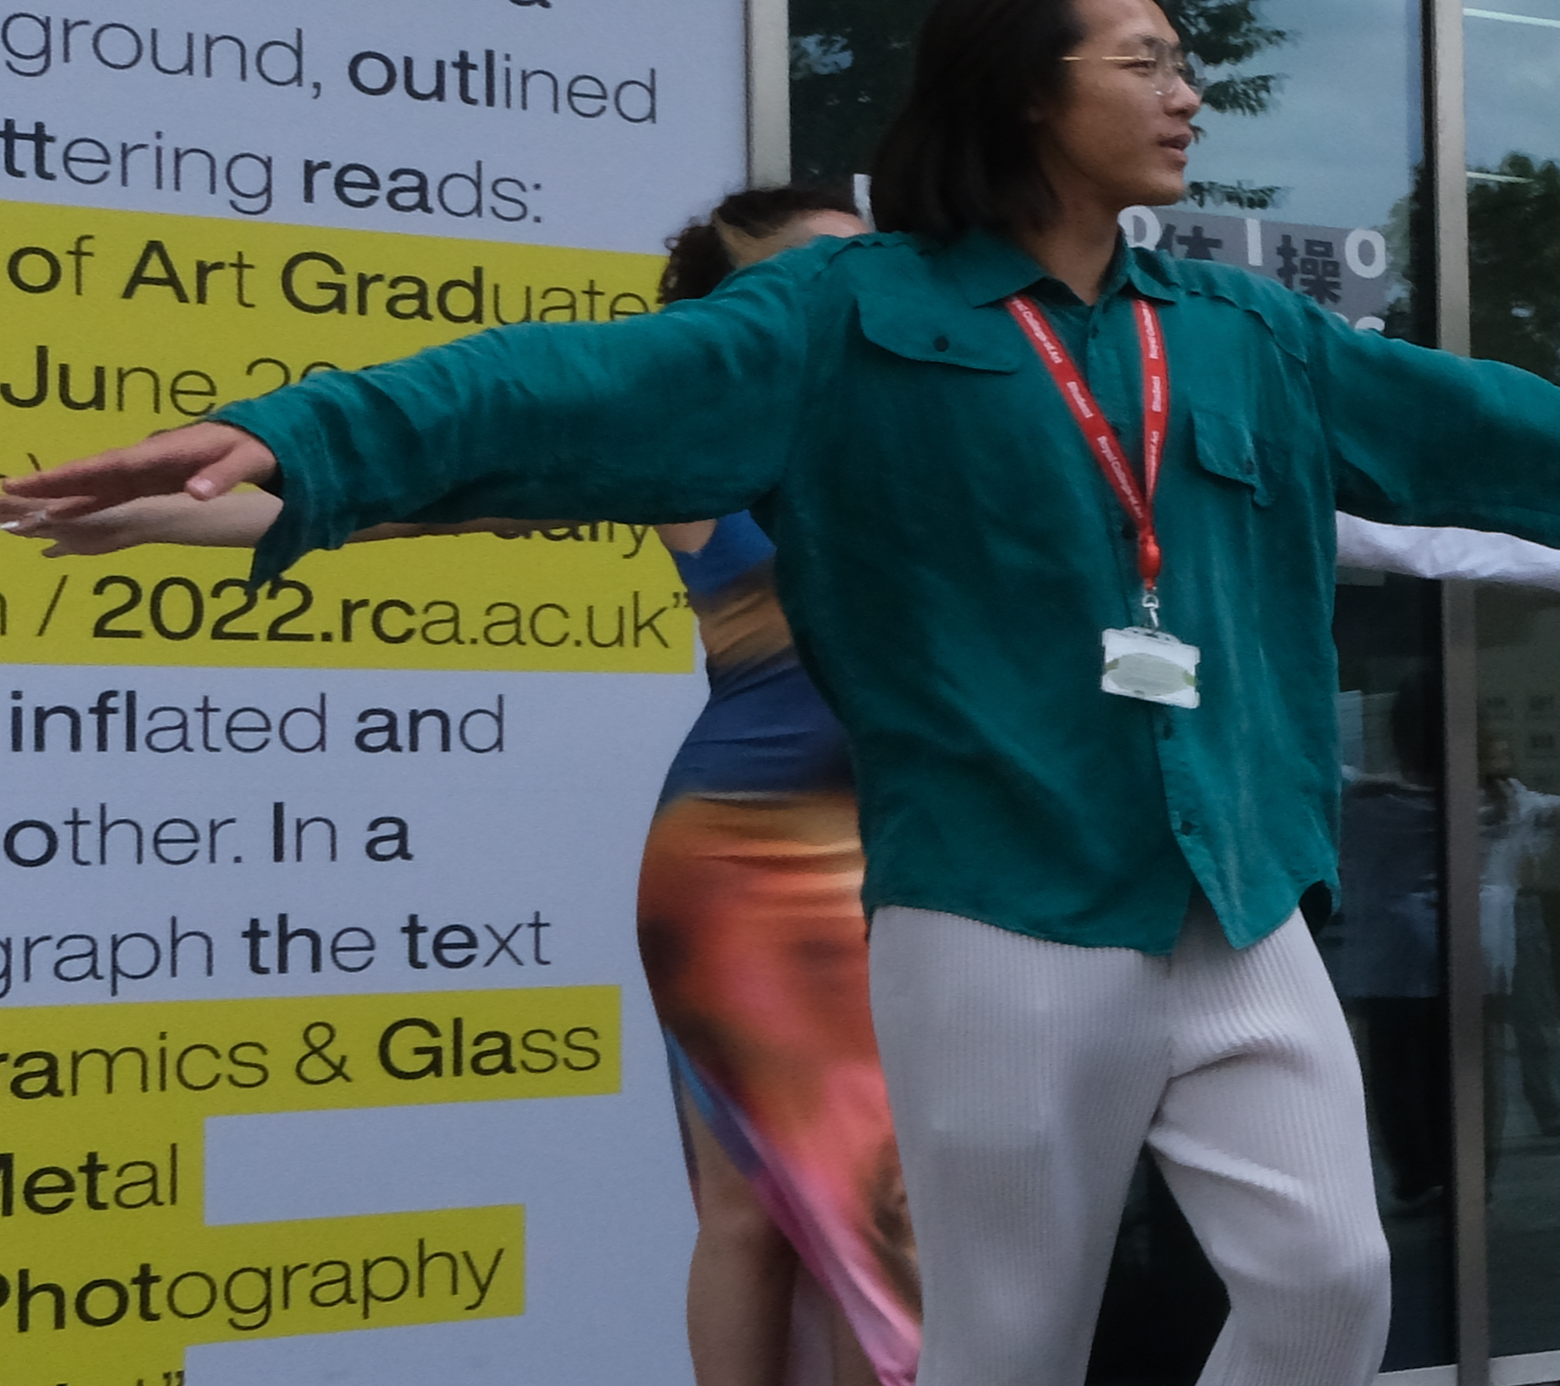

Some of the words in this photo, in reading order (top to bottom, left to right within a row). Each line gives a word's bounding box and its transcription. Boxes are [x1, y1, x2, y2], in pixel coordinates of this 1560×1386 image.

[1, 11, 323, 100] ground,
[347, 47, 658, 125] outlined
[0, 118, 274, 215] ttering
[302, 157, 544, 225] reads:
[7, 234, 95, 297] of
[121, 239, 258, 310] Art
[280, 250, 650, 325] Graduate
[0, 345, 218, 417] June
[9, 688, 328, 755] inflated
[353, 693, 506, 756] and
[3, 801, 244, 869] other.
[272, 801, 339, 864] In
[364, 815, 415, 863] a
[240, 913, 377, 977] the
[400, 910, 553, 971] text
[294, 1019, 354, 1087] &
[377, 1016, 603, 1083] Glass
[0, 1142, 180, 1217] etal
[0, 1237, 505, 1334] hotography
